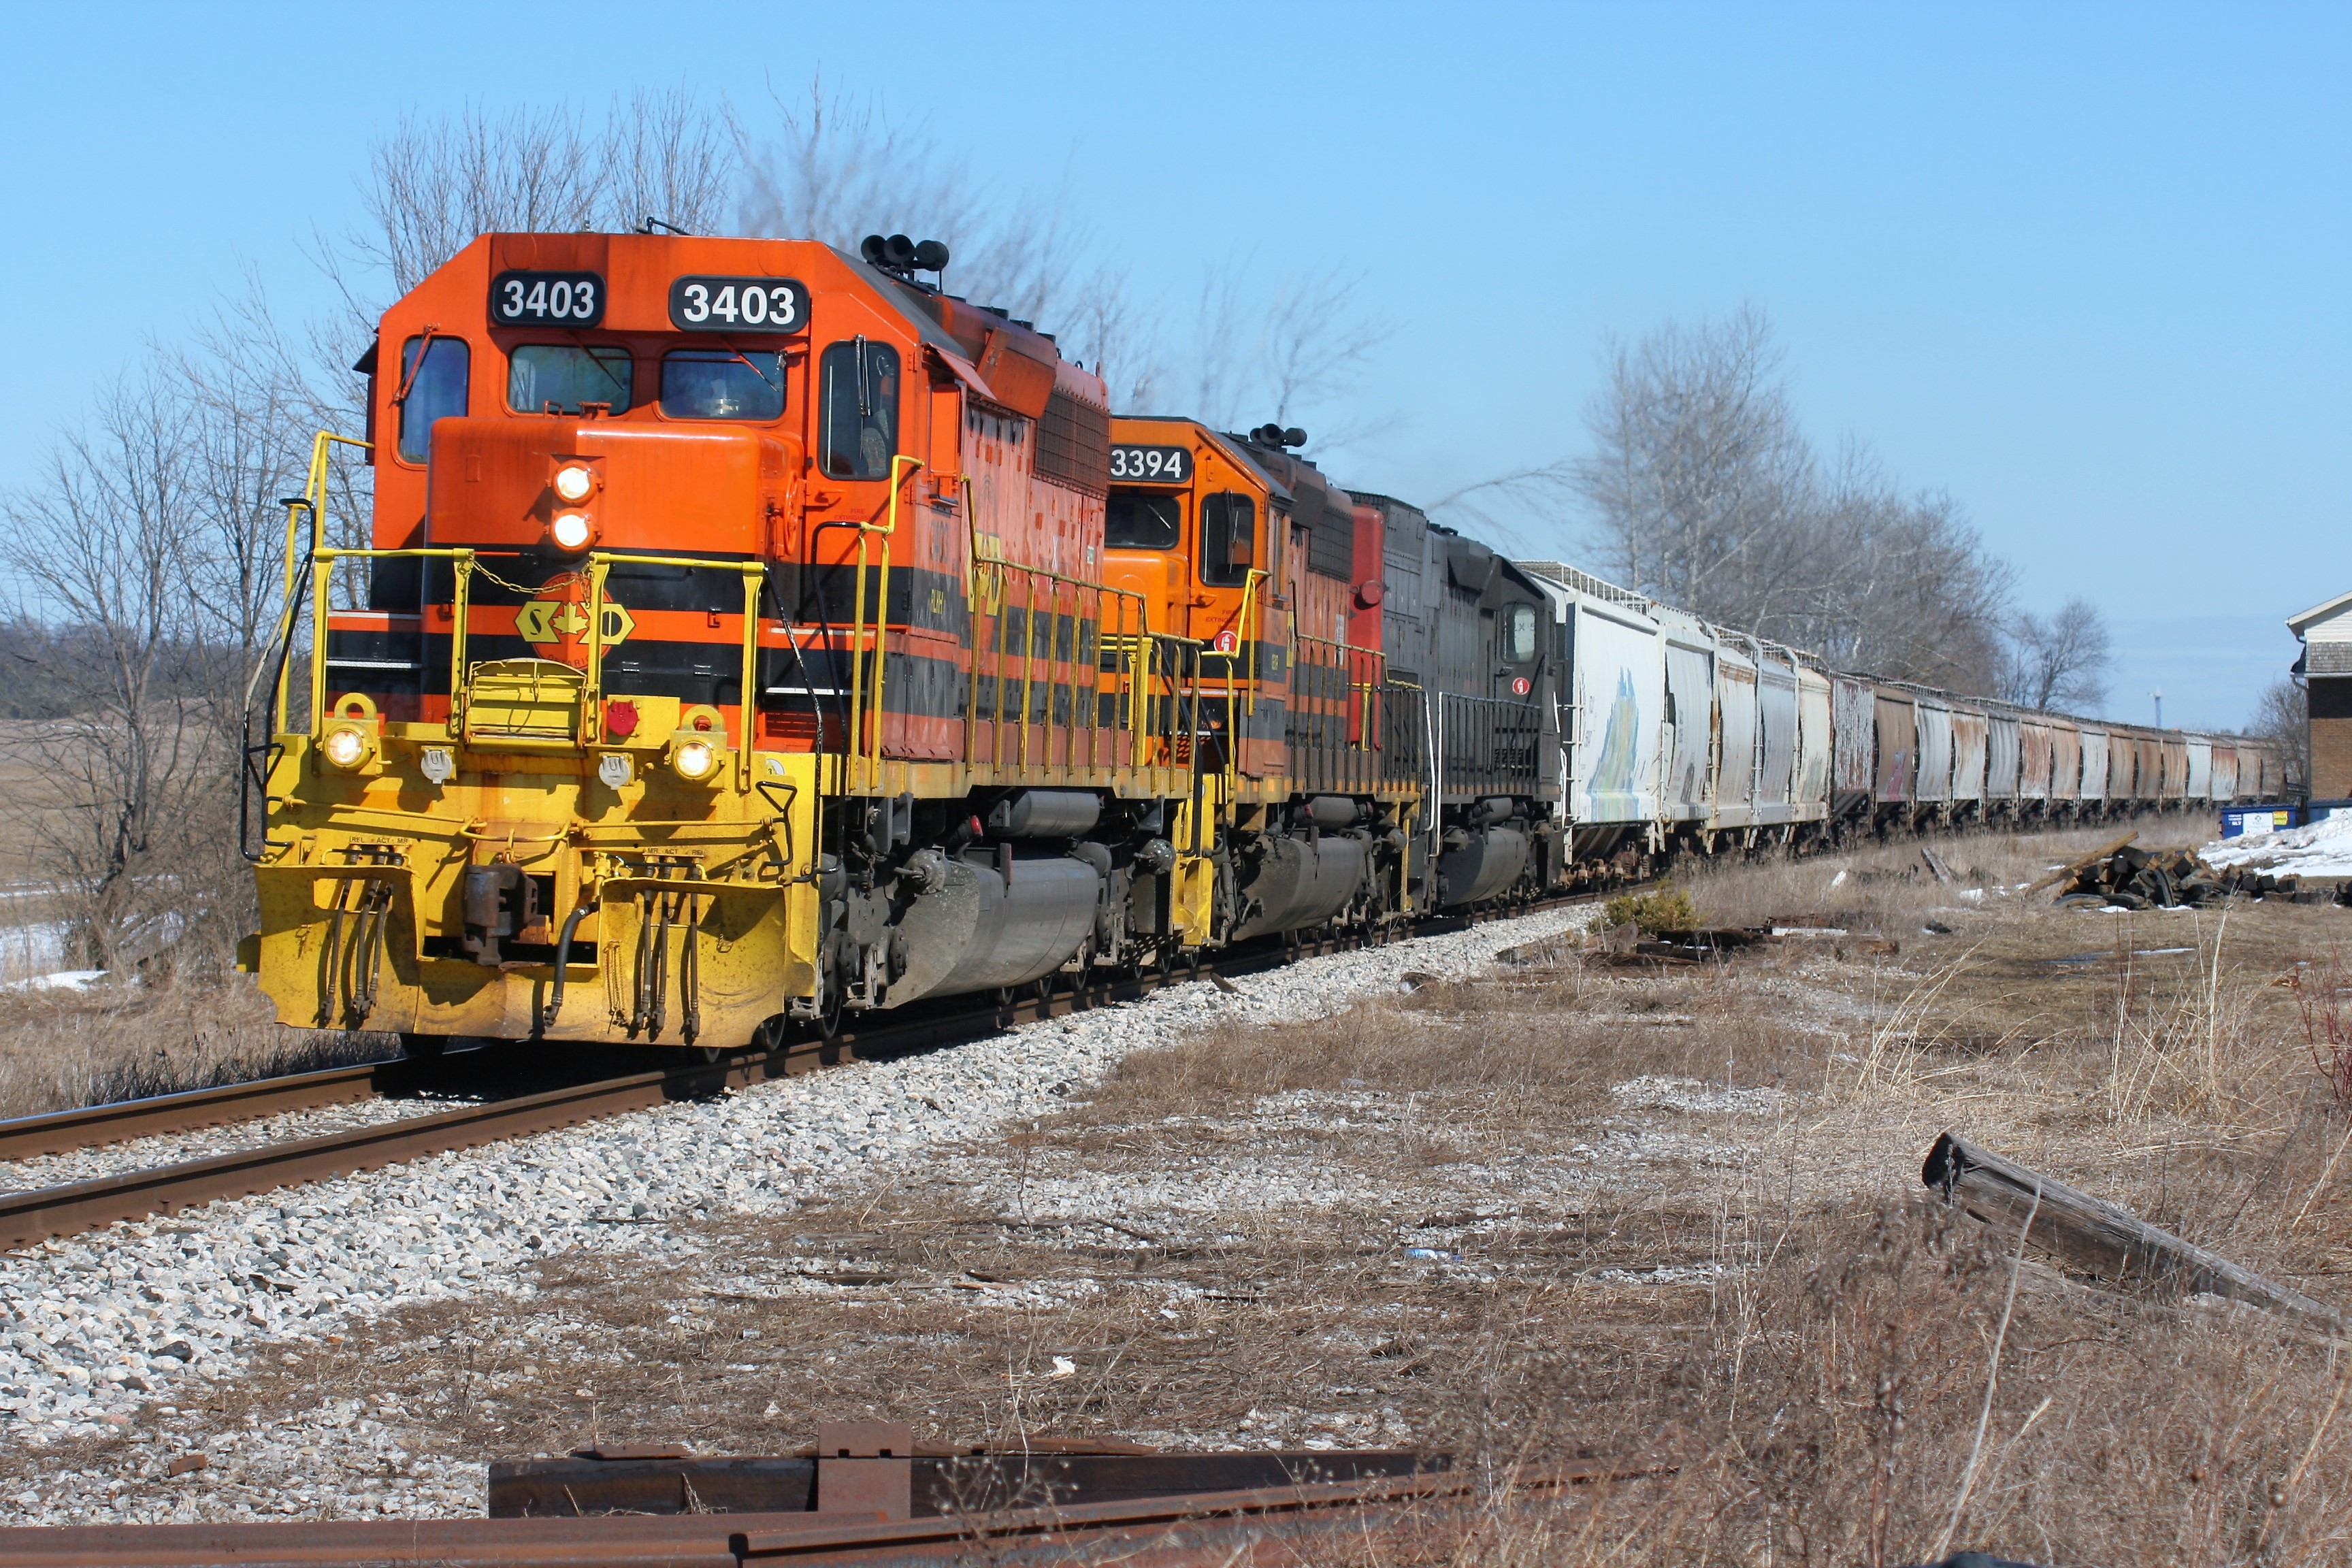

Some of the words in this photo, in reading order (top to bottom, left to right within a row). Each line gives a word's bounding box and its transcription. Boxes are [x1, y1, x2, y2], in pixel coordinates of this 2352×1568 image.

[502, 280, 594, 319] 3403
[683, 284, 796, 325] 3403
[1110, 449, 1181, 478] 3394
